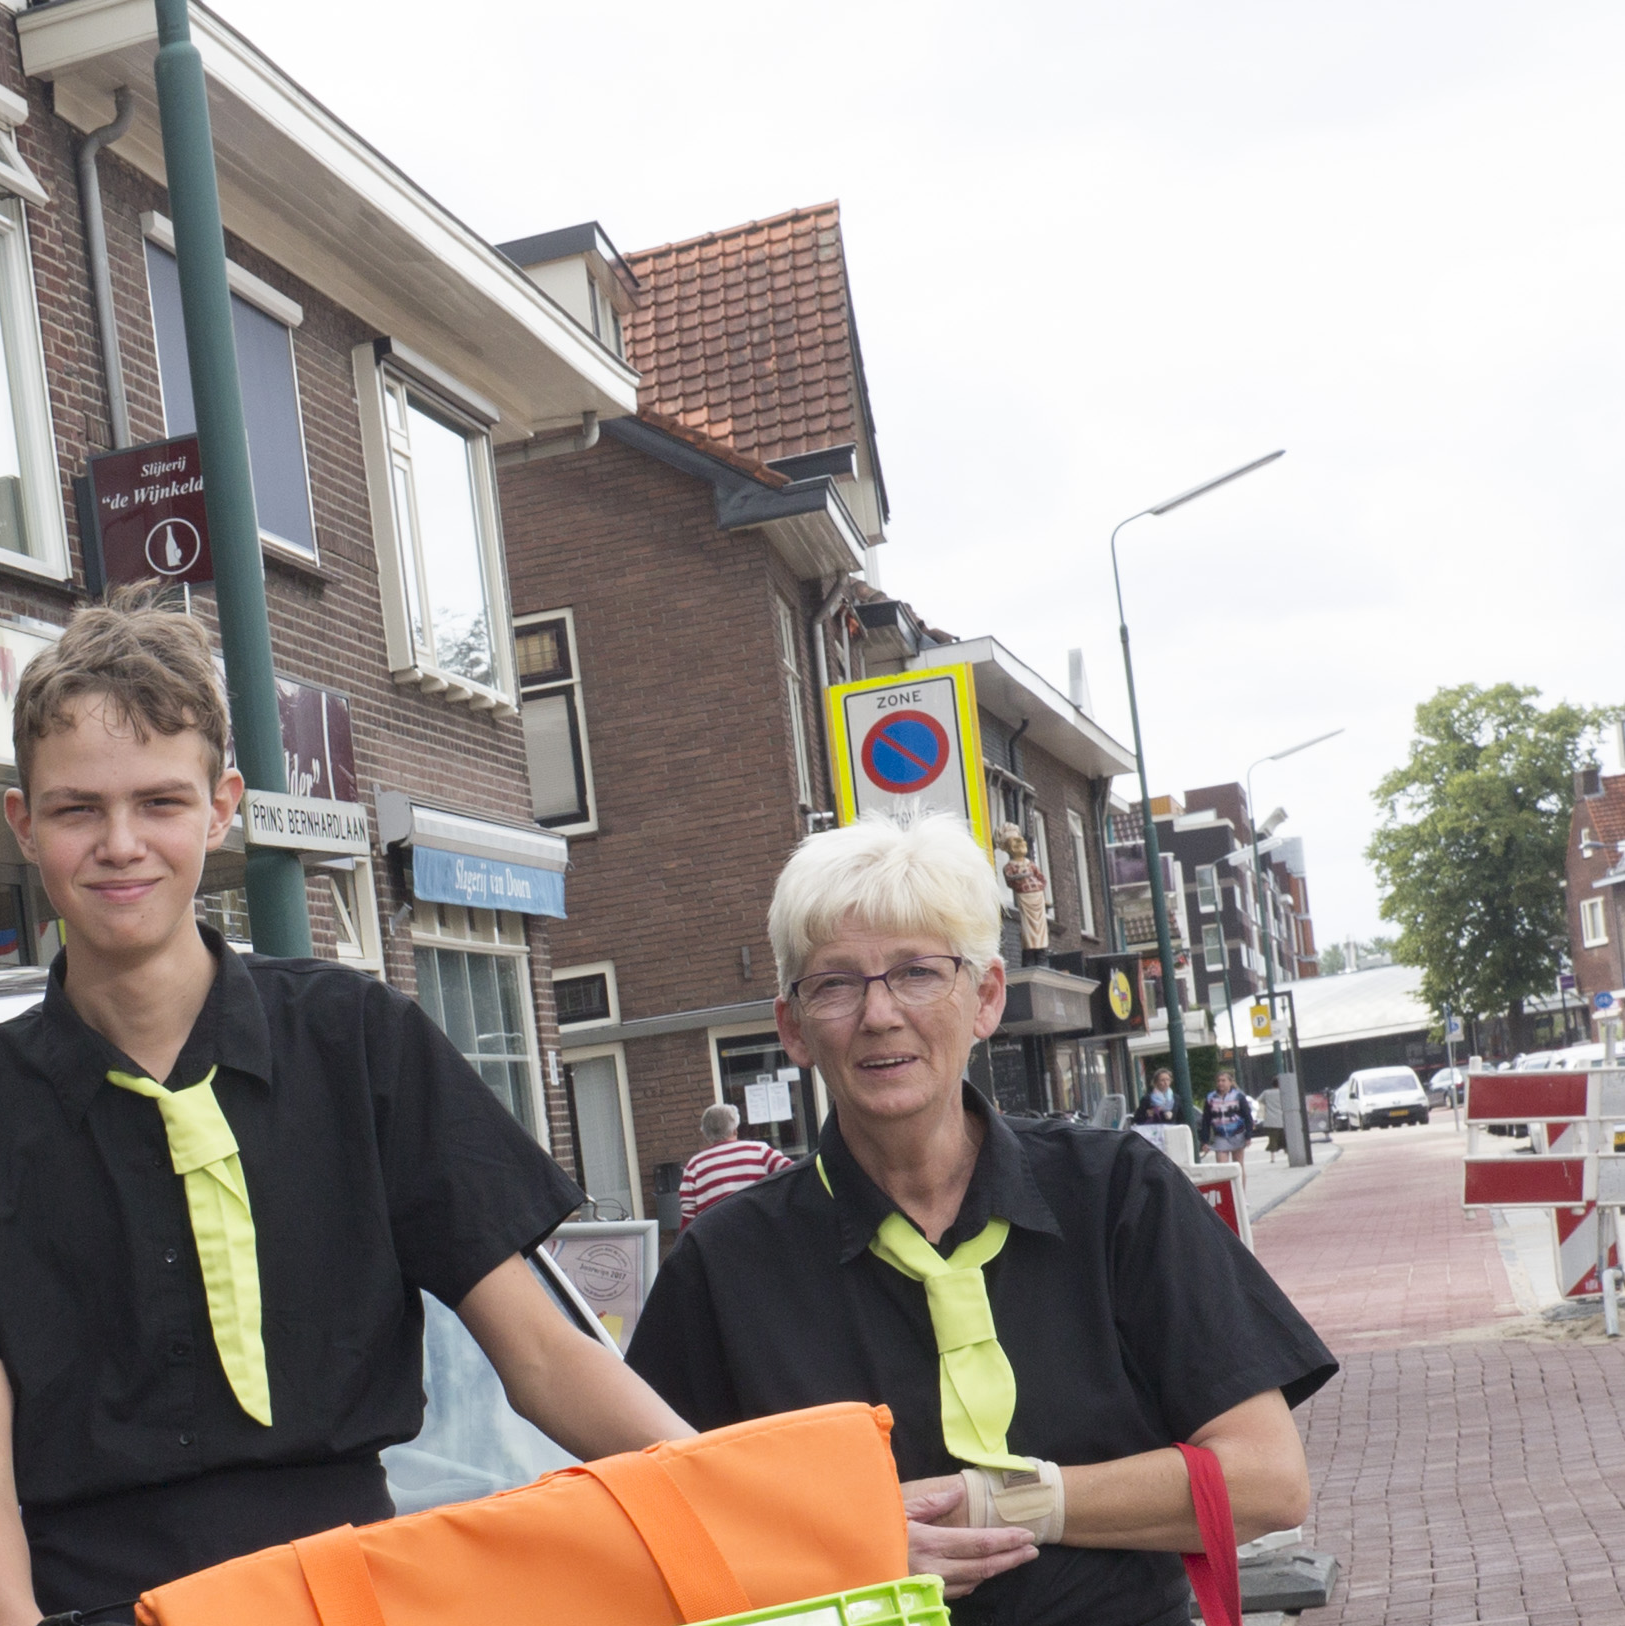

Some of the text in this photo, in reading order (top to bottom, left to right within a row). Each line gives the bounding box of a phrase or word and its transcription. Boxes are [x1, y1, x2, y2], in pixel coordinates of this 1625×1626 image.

[141, 455, 187, 478] Slijterij
[134, 475, 204, 506] Wijnkeld
[876, 690, 922, 709] ZONE
[253, 803, 367, 843] PRINS BERNHARDLAAN
[455, 858, 531, 900] Slagerij van Doorn
[1257, 1015, 1265, 1027] P
[610, 1270, 627, 1280] 2017
